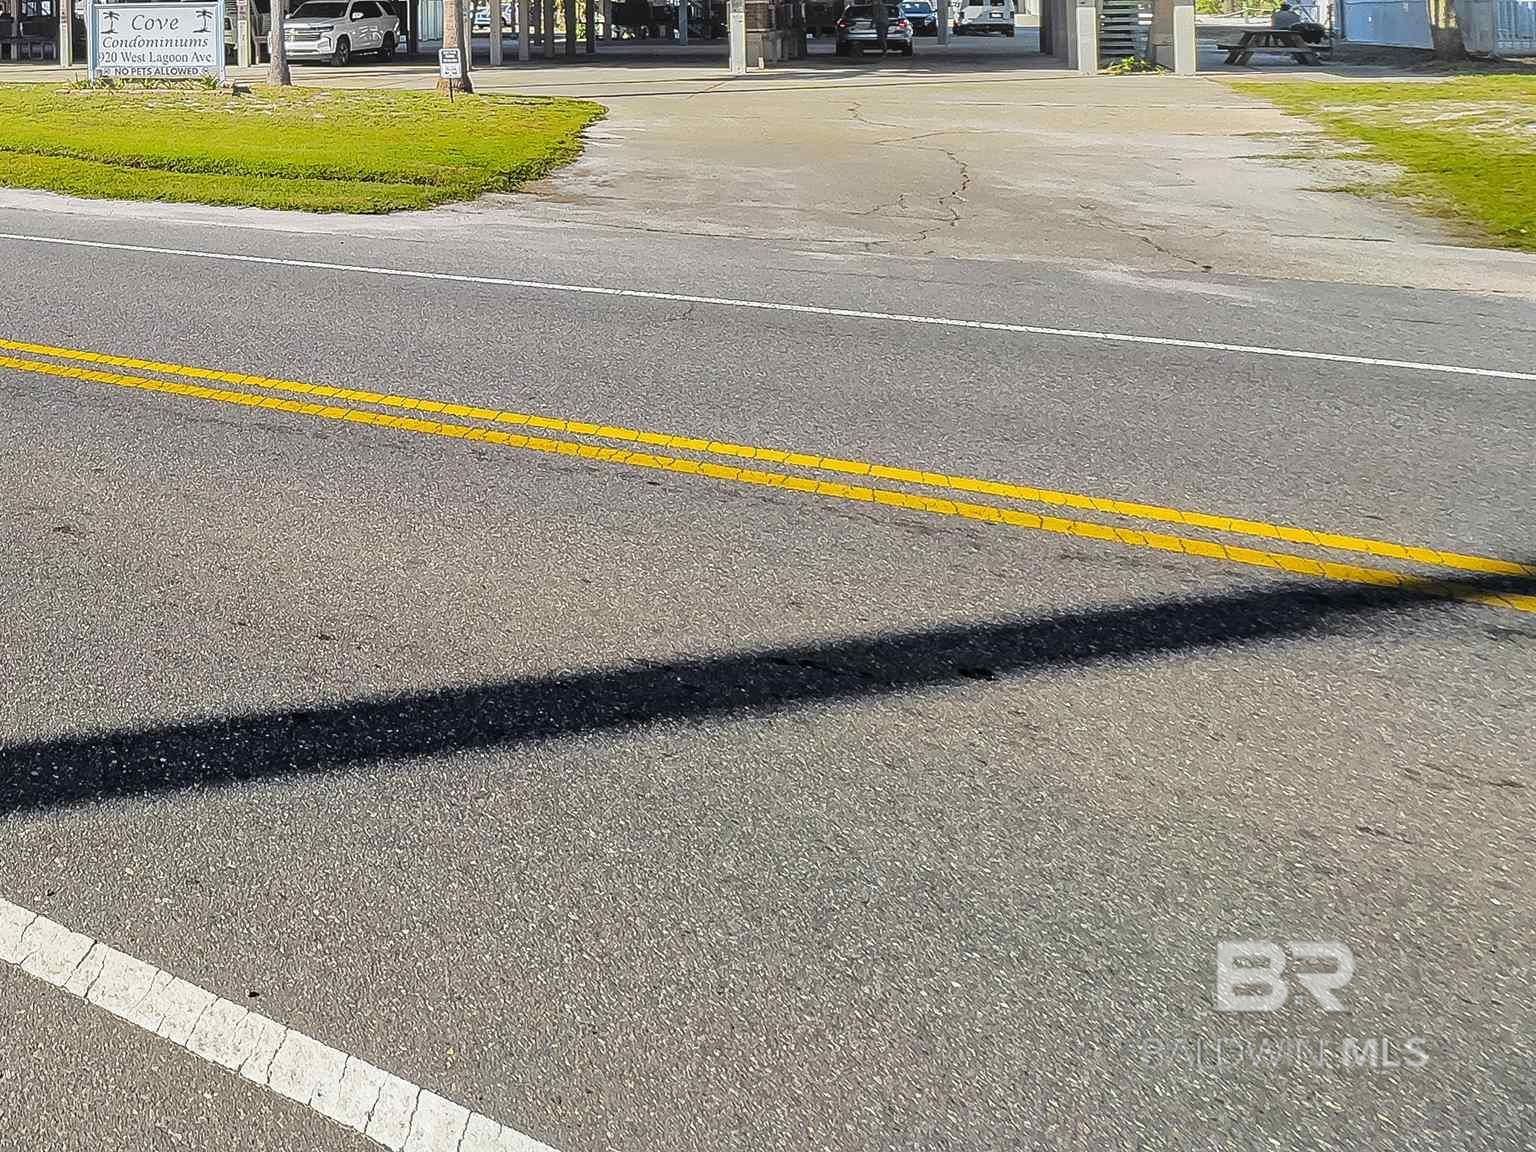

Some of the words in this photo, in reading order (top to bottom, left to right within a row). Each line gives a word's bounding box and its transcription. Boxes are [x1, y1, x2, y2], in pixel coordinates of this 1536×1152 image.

[131, 14, 179, 31] Cove
[102, 34, 209, 49] Condominiums
[121, 51, 145, 63] West
[149, 51, 188, 65] Lagoon
[115, 67, 129, 76] NO
[131, 67, 152, 76] PETS
[153, 66, 199, 75] ALLOWED
